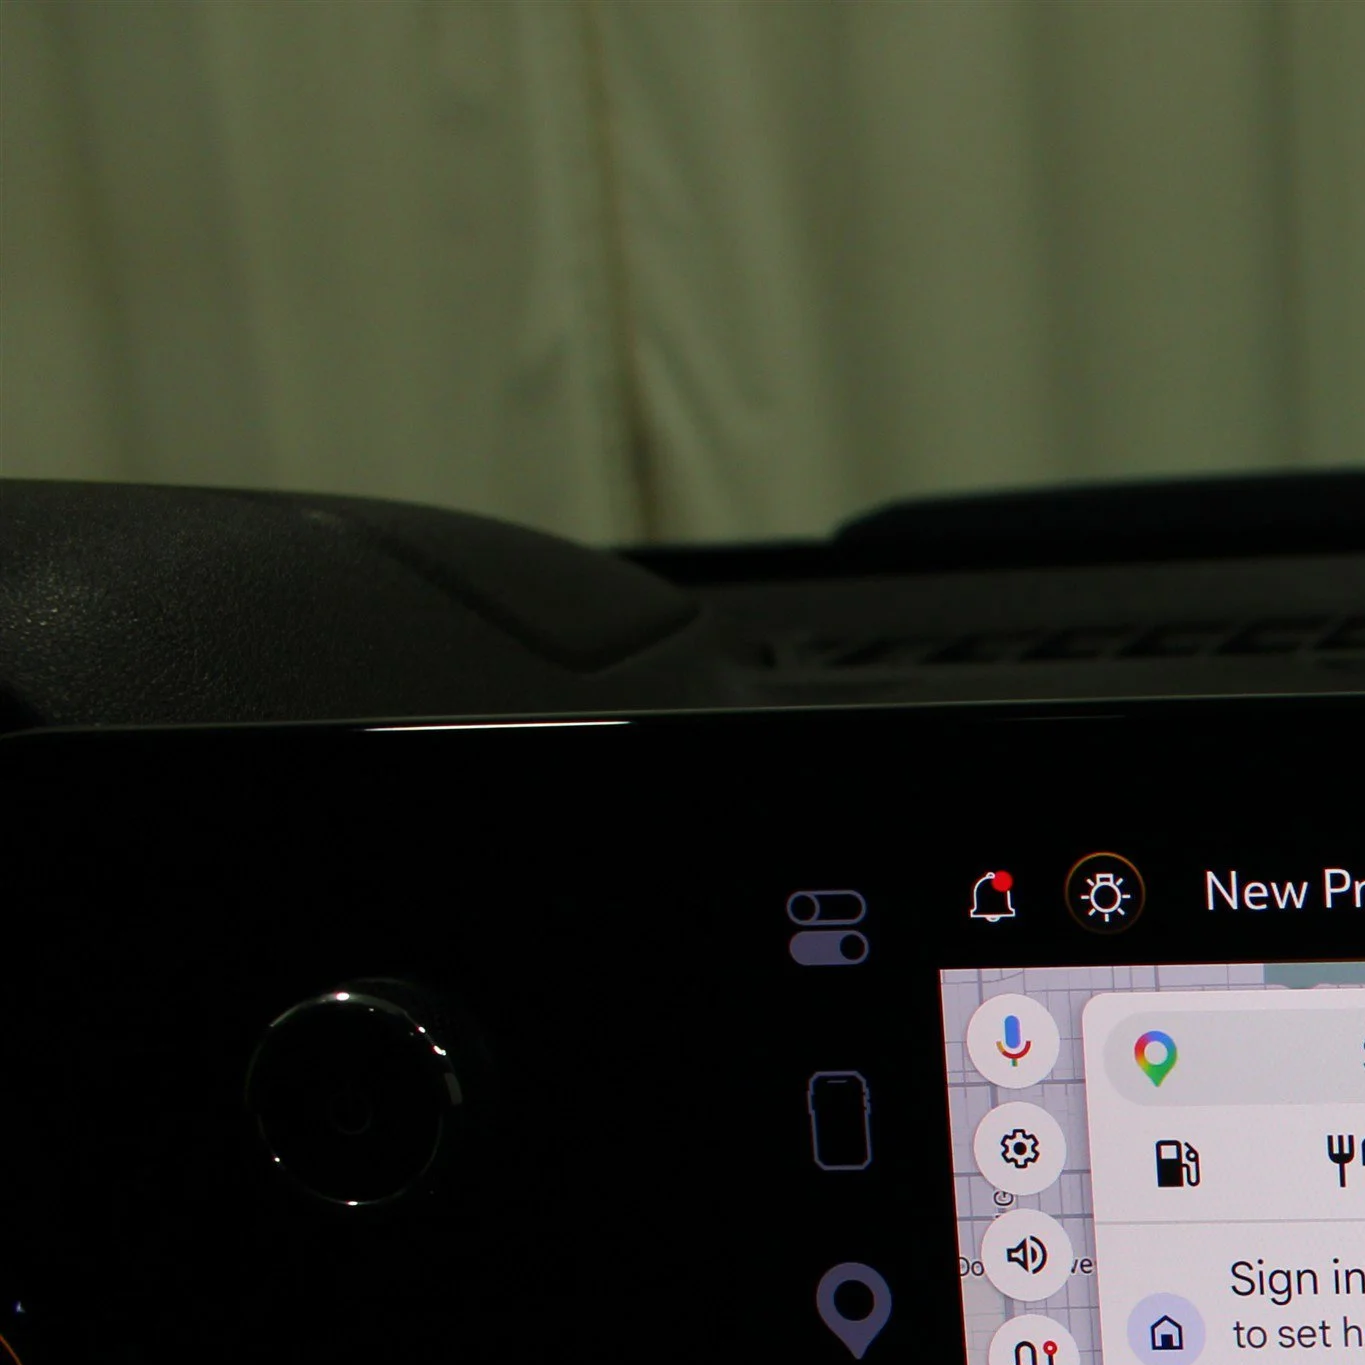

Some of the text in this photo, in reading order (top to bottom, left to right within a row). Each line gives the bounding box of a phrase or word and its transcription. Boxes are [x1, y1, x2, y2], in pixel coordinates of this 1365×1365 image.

[1206, 870, 1309, 911] New
[1231, 1258, 1318, 1306] Sign
[1233, 1321, 1267, 1349] to
[1278, 1320, 1332, 1349] set
